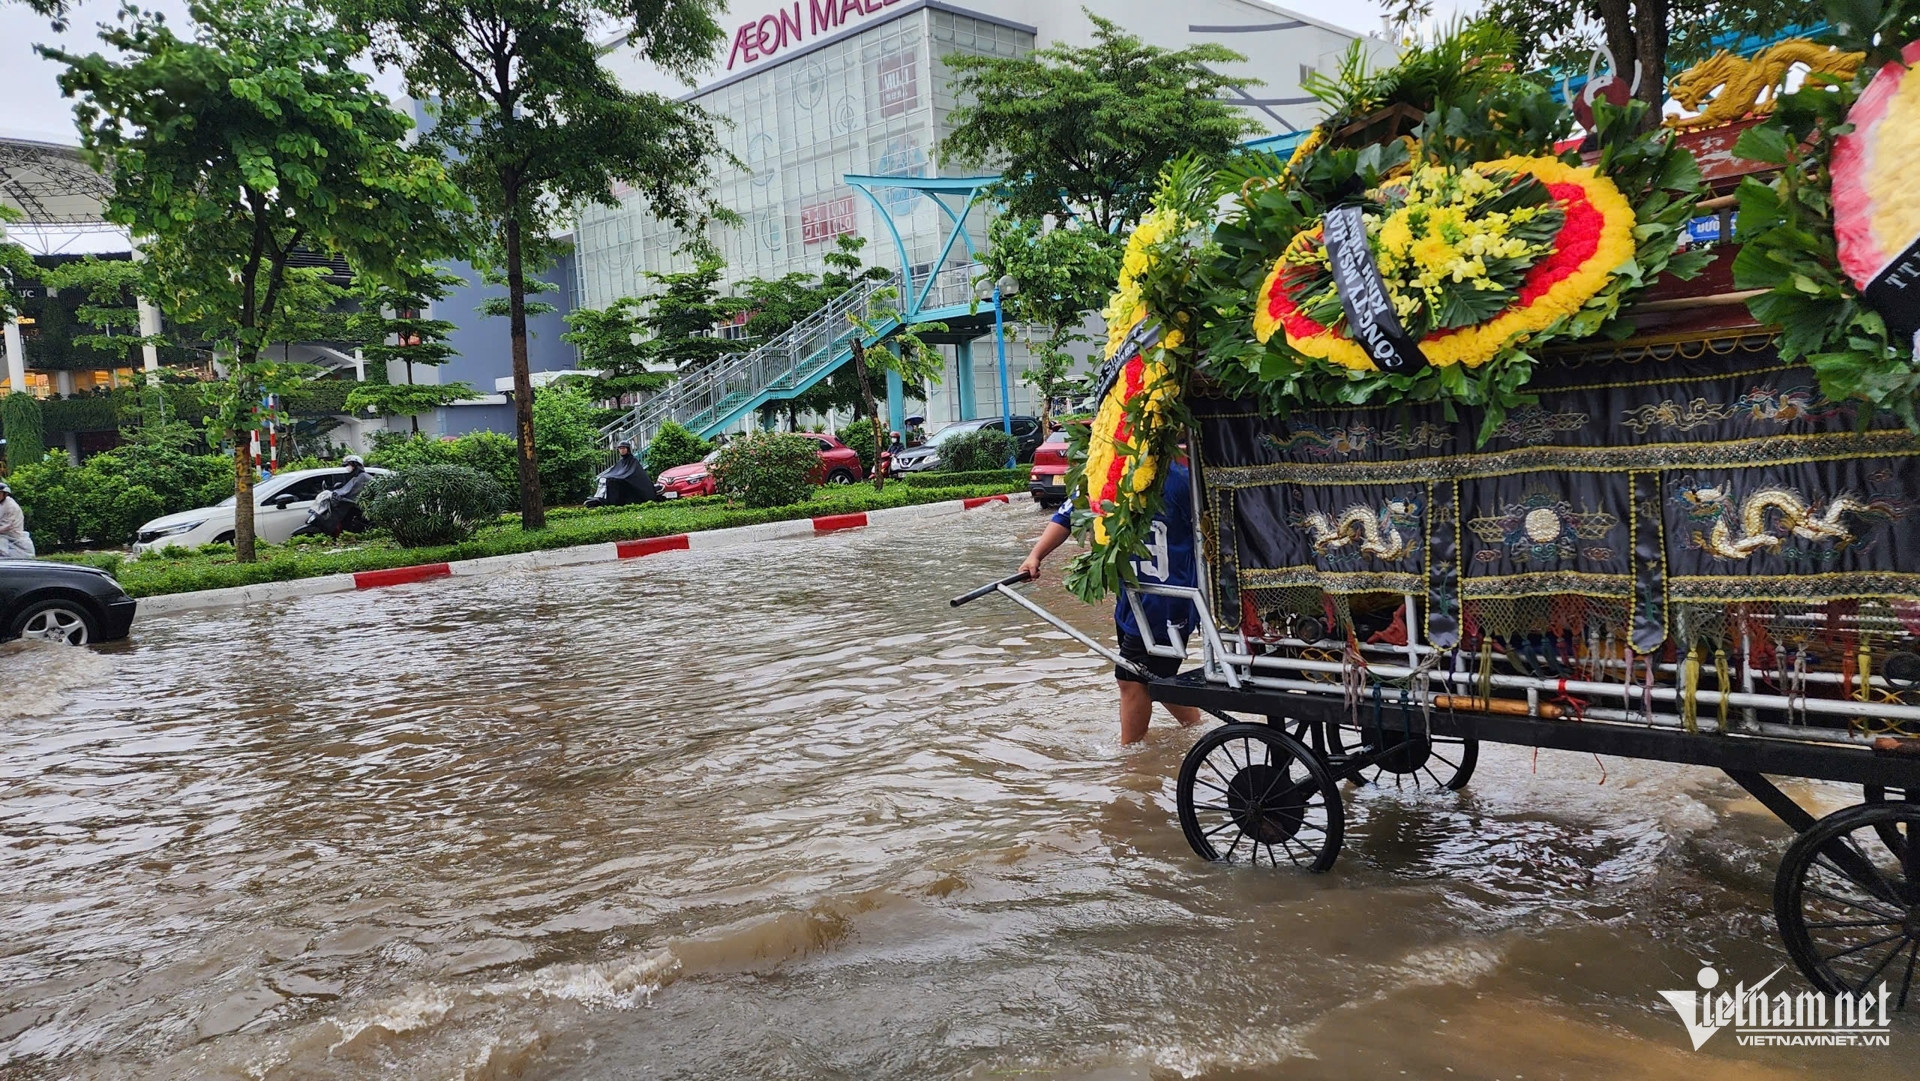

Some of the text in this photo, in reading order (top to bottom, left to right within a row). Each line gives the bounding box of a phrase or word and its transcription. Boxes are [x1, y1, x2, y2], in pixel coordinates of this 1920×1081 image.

[1884, 250, 1920, 290] TT
[1347, 283, 1368, 315] TY
[1359, 310, 1404, 367] CÔNG
